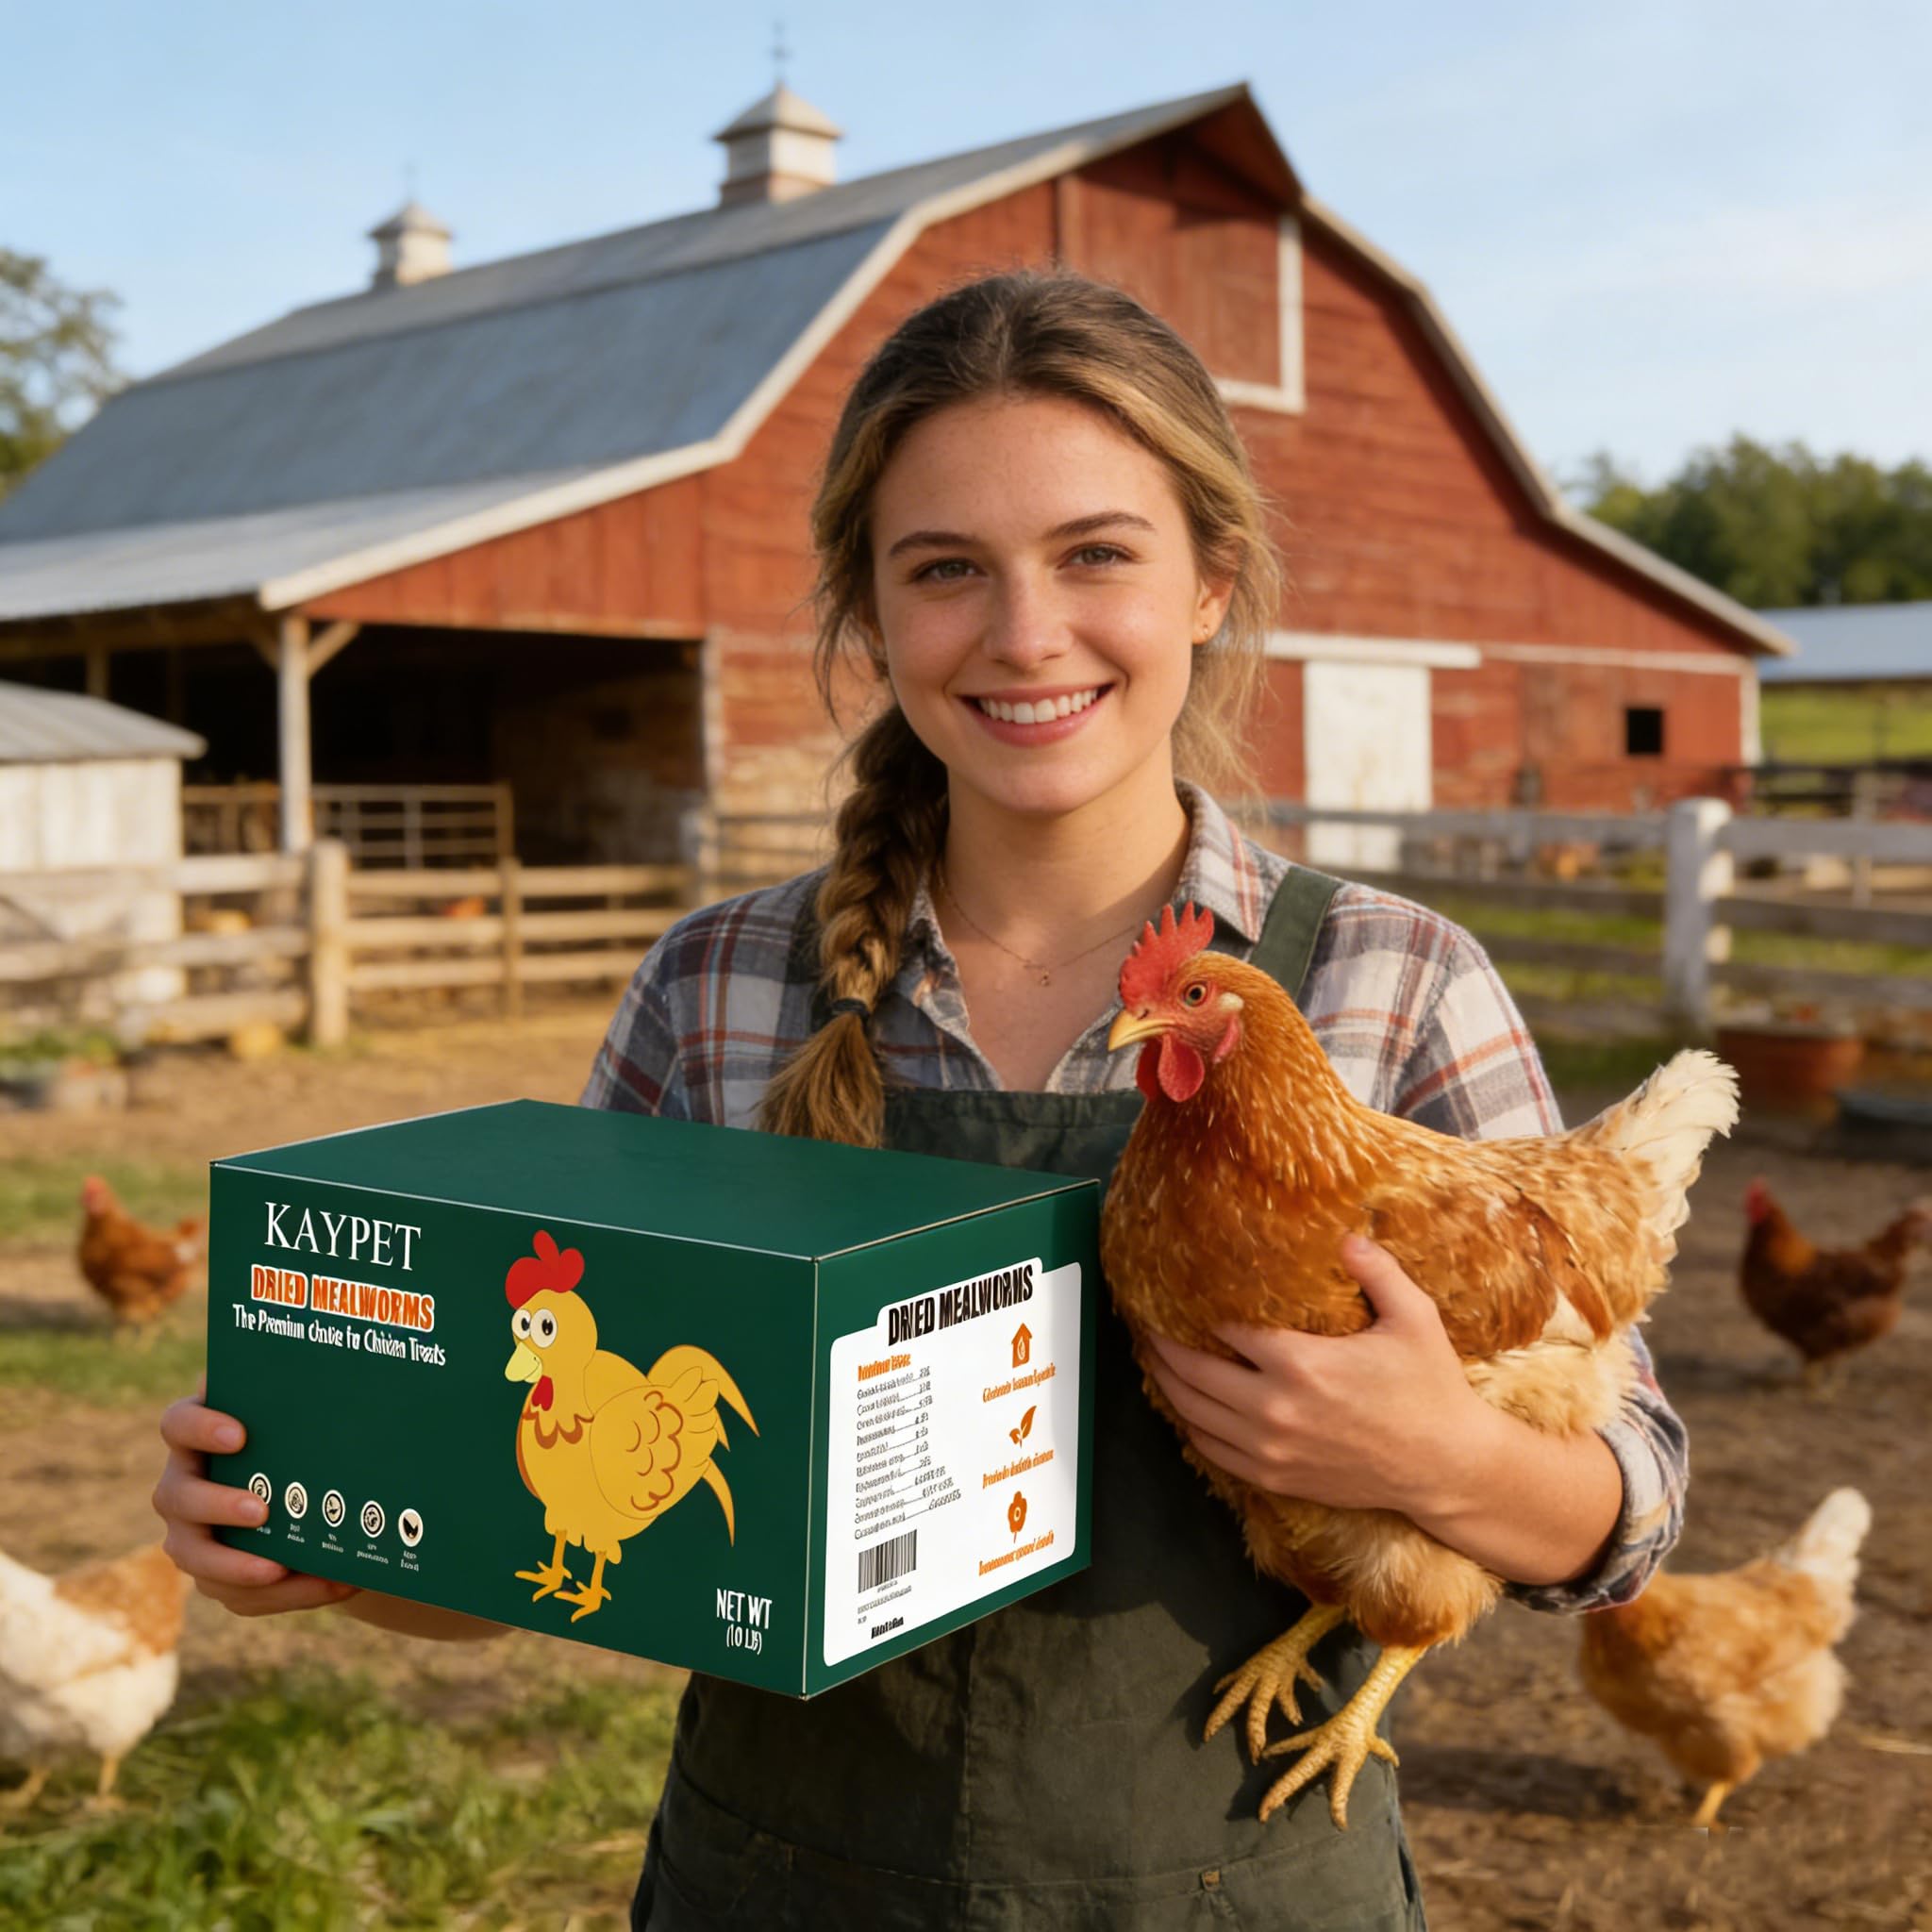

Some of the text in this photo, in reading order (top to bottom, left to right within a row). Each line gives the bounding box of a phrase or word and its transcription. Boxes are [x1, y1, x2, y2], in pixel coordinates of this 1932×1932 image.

[263, 1201, 422, 1272] KAYPET
[232, 1304, 257, 1330] The
[251, 1264, 435, 1332] DRIED MEALWORMS
[888, 1295, 936, 1347] DRIED
[716, 1588, 773, 1630] NET WT
[726, 1623, 743, 1648] (10
